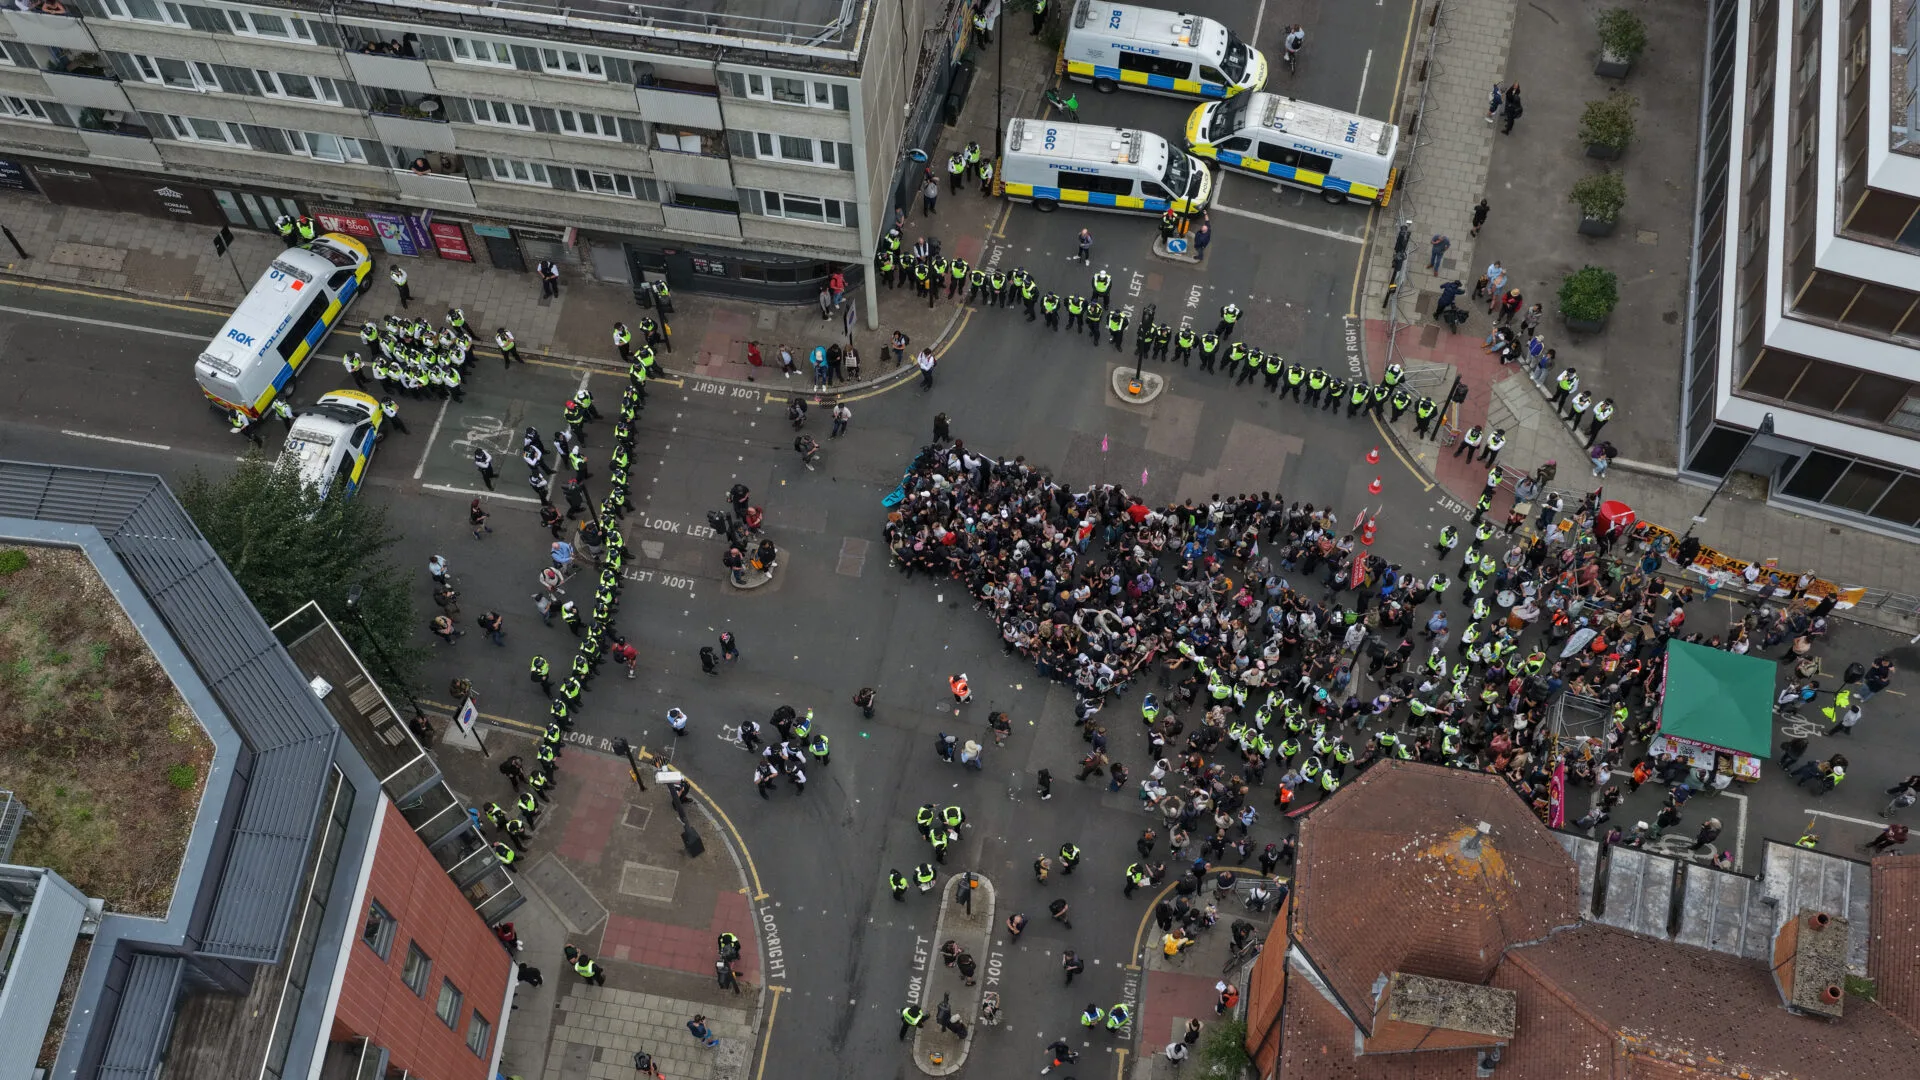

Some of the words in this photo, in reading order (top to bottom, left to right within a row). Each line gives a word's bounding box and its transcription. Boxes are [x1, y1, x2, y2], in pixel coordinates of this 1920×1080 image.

[1109, 9, 1122, 30] BCZ
[1182, 19, 1193, 29] 01
[1111, 43, 1160, 56] POLICE
[1257, 62, 1266, 82] POLICE
[1273, 116, 1285, 129] 01
[1344, 120, 1360, 143] BMK
[1044, 128, 1057, 150] GGC
[1120, 132, 1131, 145] 01
[1293, 143, 1344, 159] POLICE
[1049, 163, 1100, 174] POLICE
[988, 245, 1005, 267] LOOK
[270, 270, 285, 281] 01
[1128, 271, 1144, 297] LEFT
[1186, 284, 1203, 309] LOOK
[1180, 315, 1194, 331] LE
[226, 328, 256, 347] RQK
[258, 313, 292, 357] POLICE
[1345, 320, 1359, 351] RIGHT
[1347, 355, 1362, 378] LOOK
[692, 381, 726, 395] RIGHT
[730, 387, 760, 400] LOOK
[289, 440, 305, 451] 01
[1437, 496, 1474, 521] RIGHT
[644, 517, 680, 534] LOOK
[687, 524, 717, 539] LEFT
[621, 567, 653, 582] LEFT
[661, 575, 695, 591] LOOK
[1397, 722, 1438, 739] LEFT
[562, 731, 594, 746] LOOK
[600, 738, 638, 753] RIT
[767, 938, 786, 979] RIGHT
[912, 935, 929, 971] LEFT
[986, 952, 1003, 985] LOOK
[907, 975, 922, 1005] LOOK
